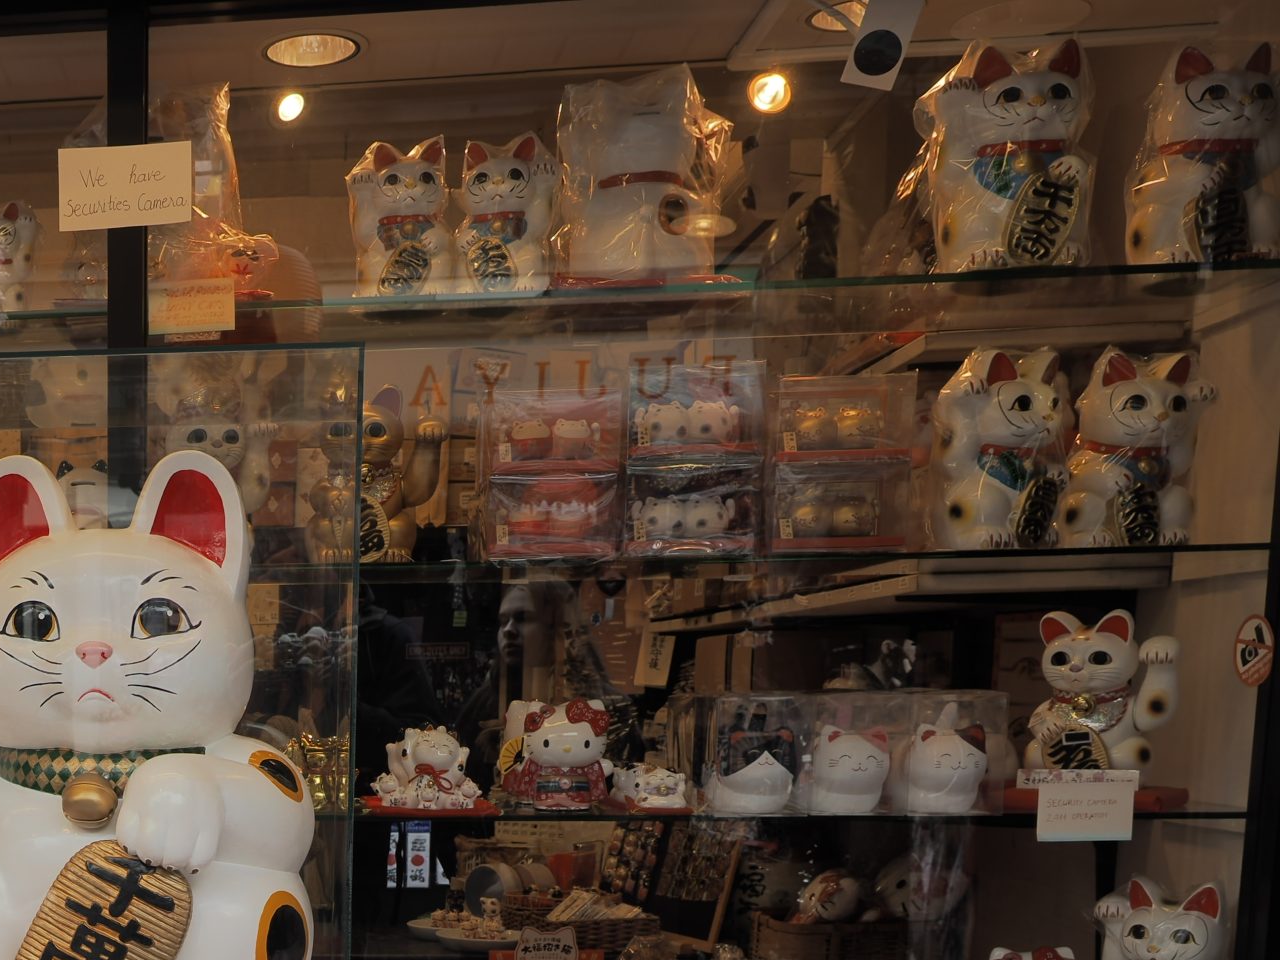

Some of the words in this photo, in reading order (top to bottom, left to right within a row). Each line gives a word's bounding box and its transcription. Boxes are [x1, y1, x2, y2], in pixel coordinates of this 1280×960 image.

[80, 168, 107, 188] We
[129, 163, 166, 185] have
[64, 193, 131, 218] Securities
[137, 192, 187, 212] Camera
